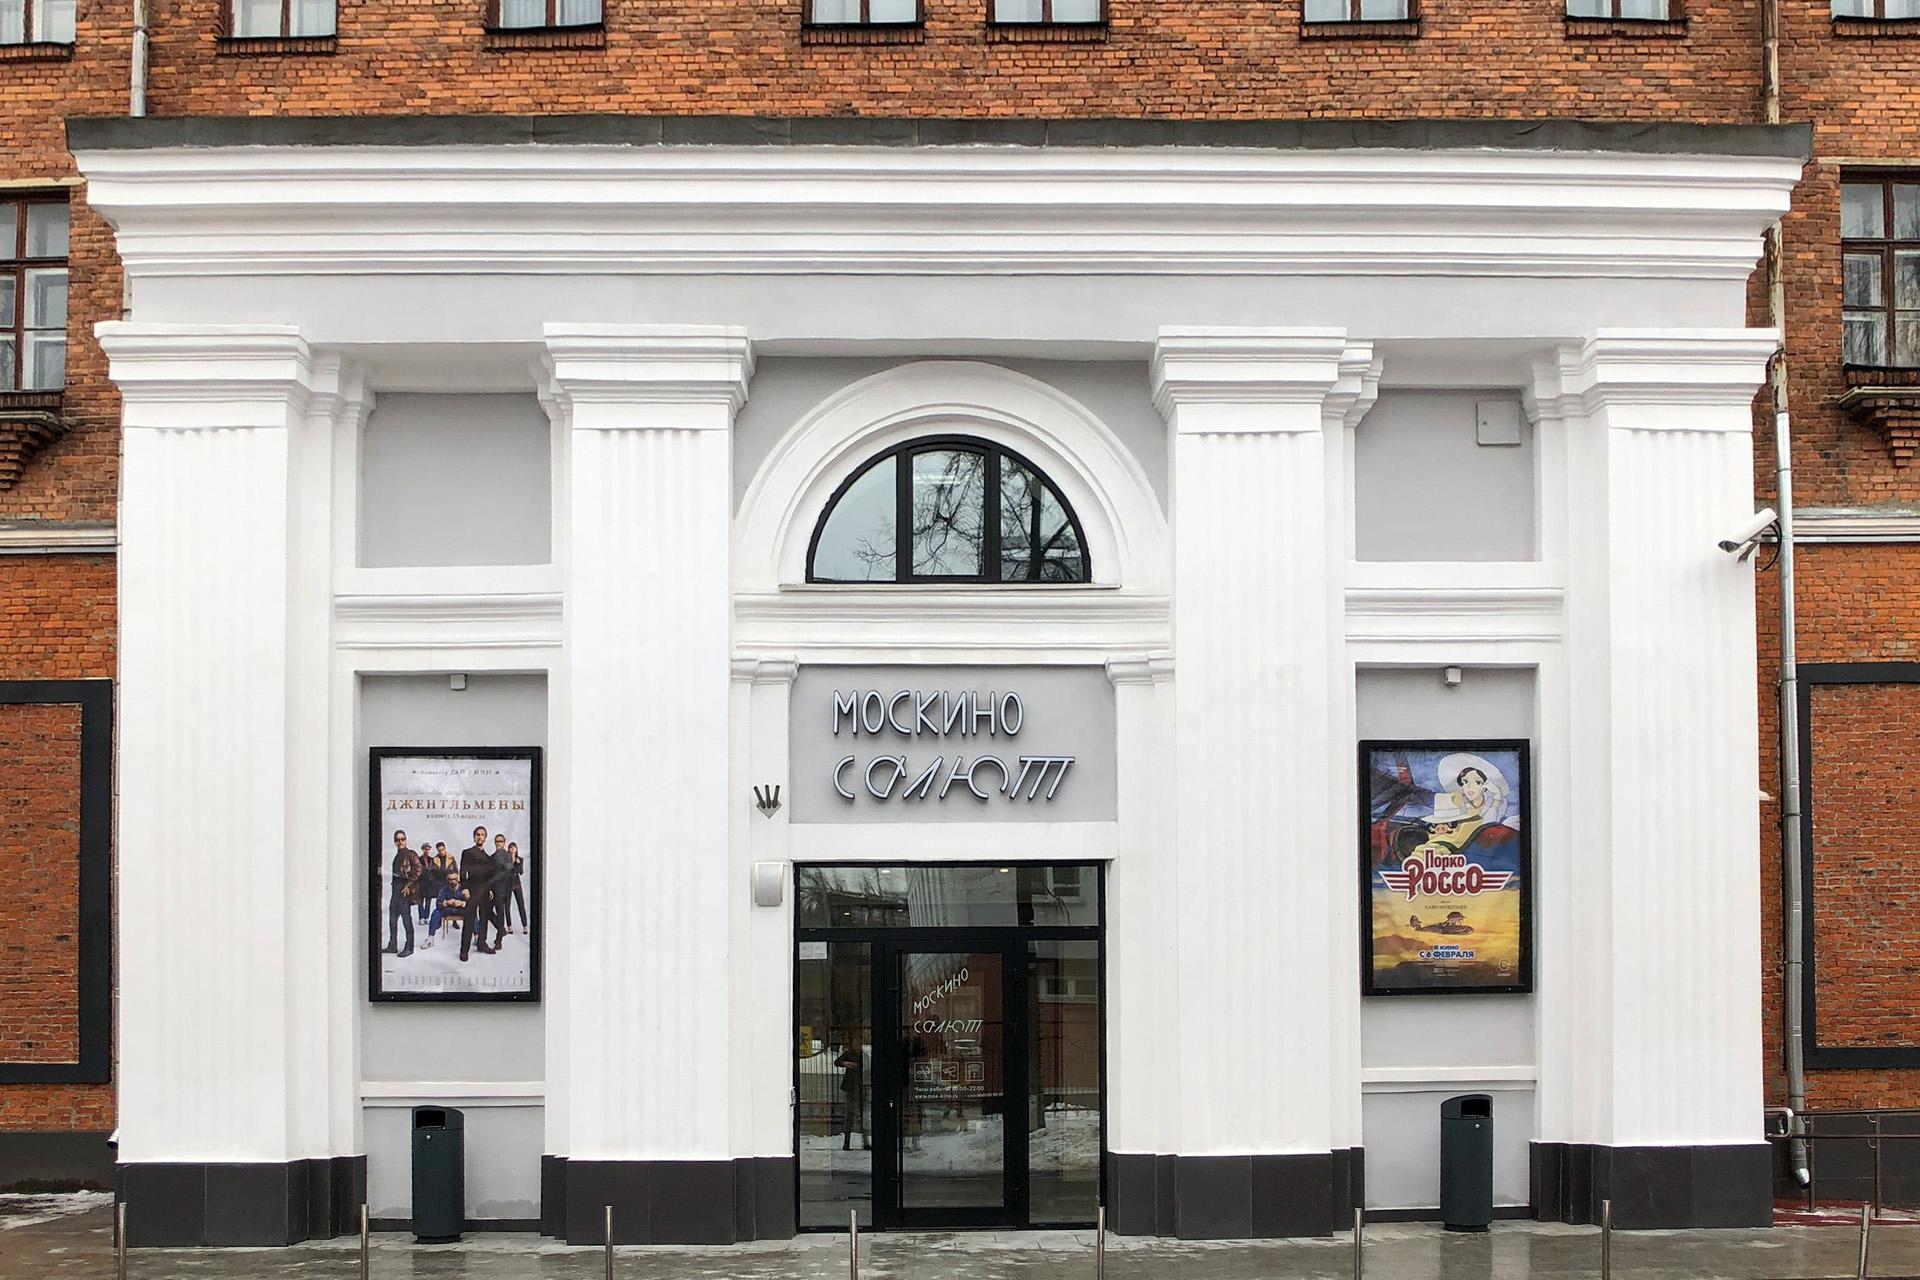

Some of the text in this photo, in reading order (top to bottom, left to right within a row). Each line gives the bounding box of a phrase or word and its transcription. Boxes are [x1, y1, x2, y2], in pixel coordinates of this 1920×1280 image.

[832, 689, 1024, 735] МОСКИНО
[832, 755, 1076, 799] САЛЮТ
[387, 799, 526, 811] ДЖЕНТЛЬМЕНЫ
[1433, 950, 1475, 958] ФЕВРАЛЯ
[913, 967, 969, 1015] МОСКИНО
[913, 1019, 984, 1034] САЛЮТ
